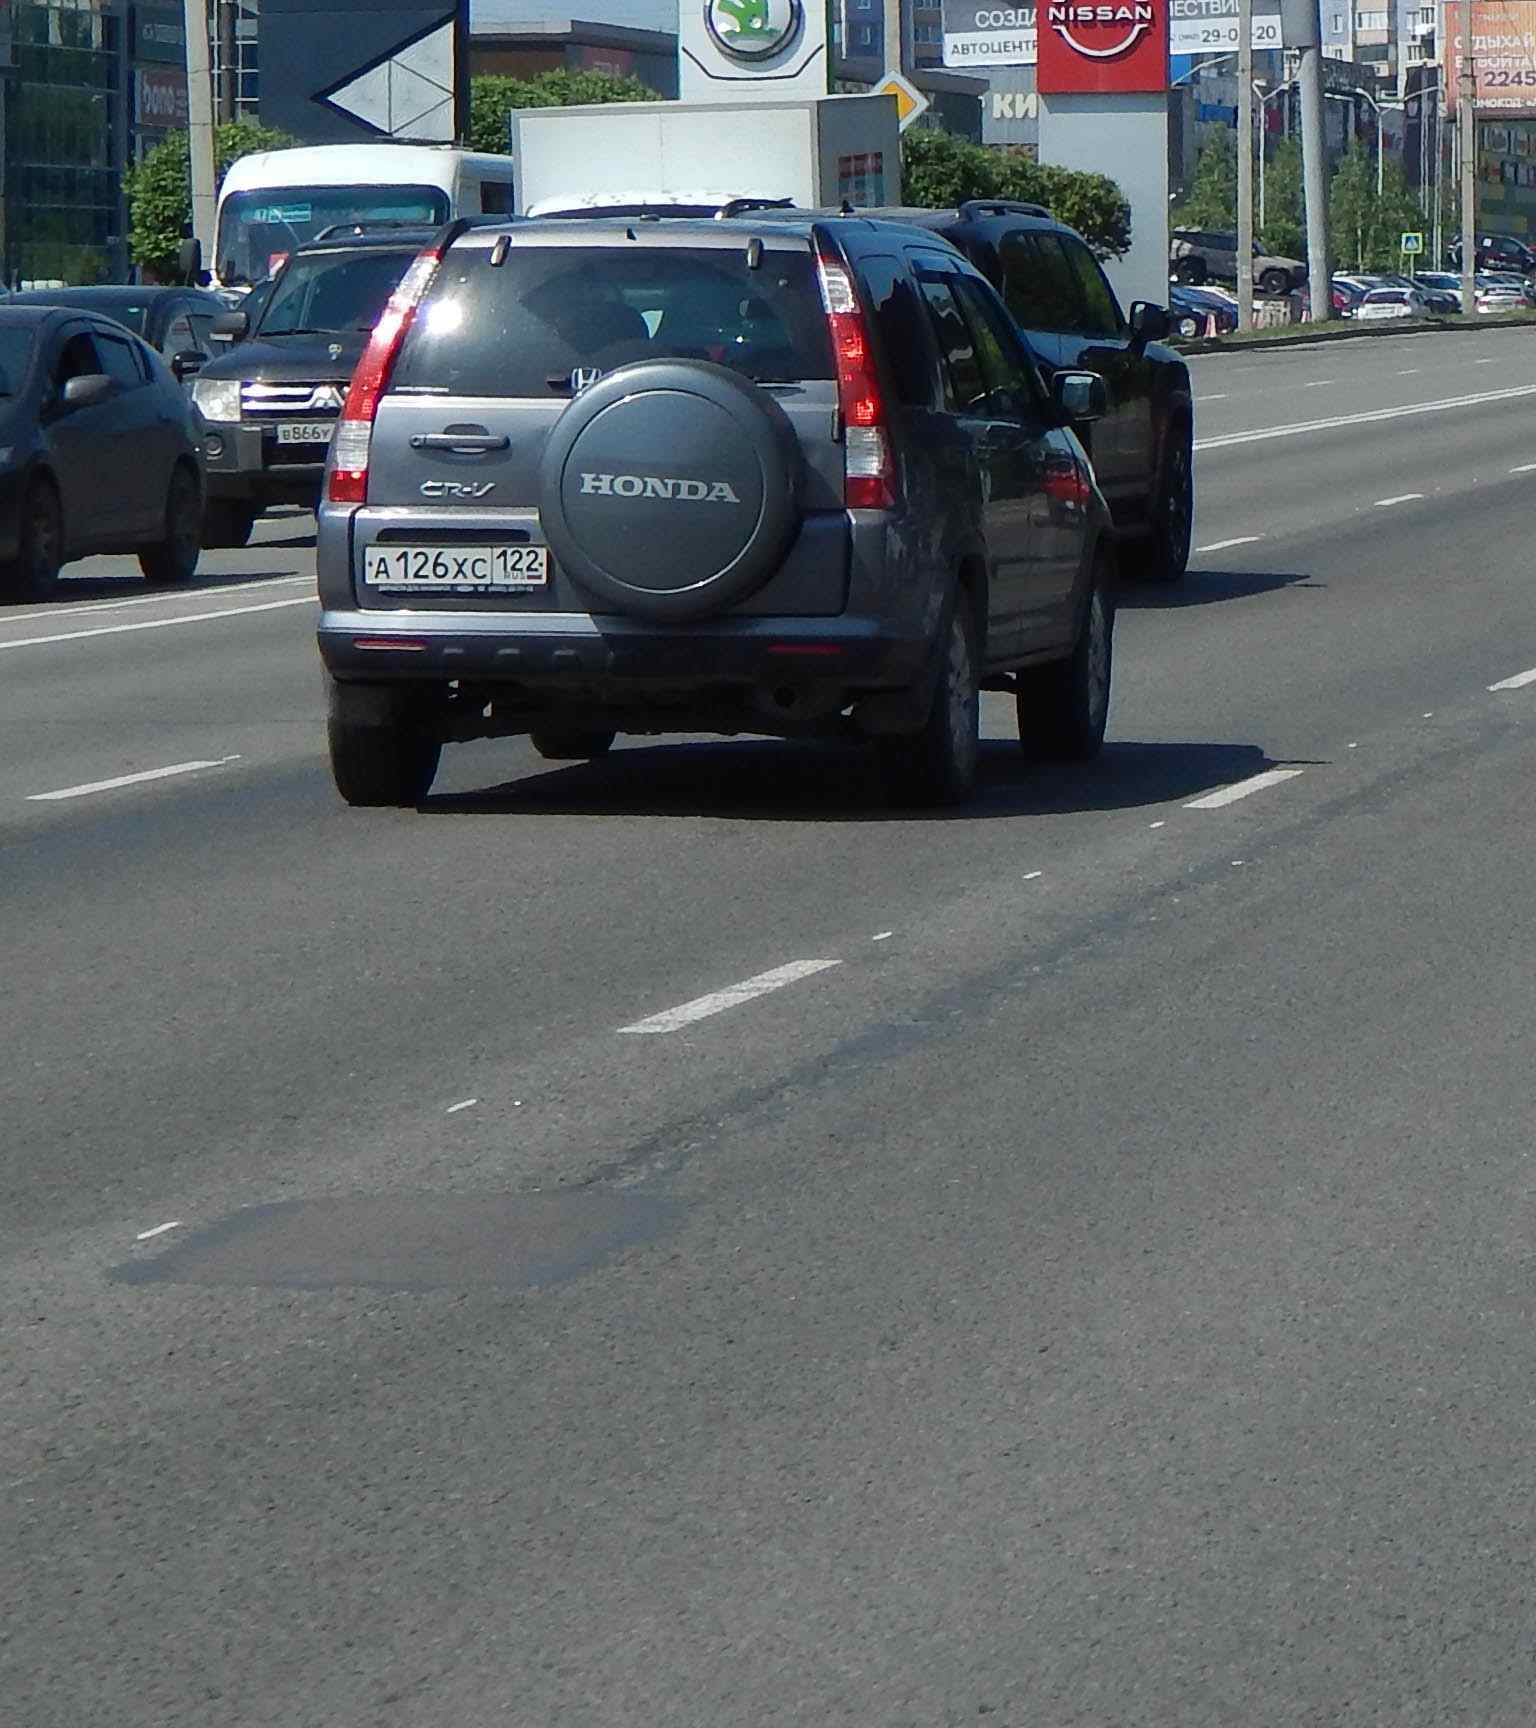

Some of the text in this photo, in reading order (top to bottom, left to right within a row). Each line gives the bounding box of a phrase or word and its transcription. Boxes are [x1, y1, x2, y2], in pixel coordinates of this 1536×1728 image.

[1048, 5, 1153, 21] NISSAN
[1201, 25, 1277, 43] 29-0-20
[1454, 32, 1534, 50] ОДЫХАЙ
[580, 473, 741, 503] HONDA
[374, 549, 540, 580] А126ХС 122
